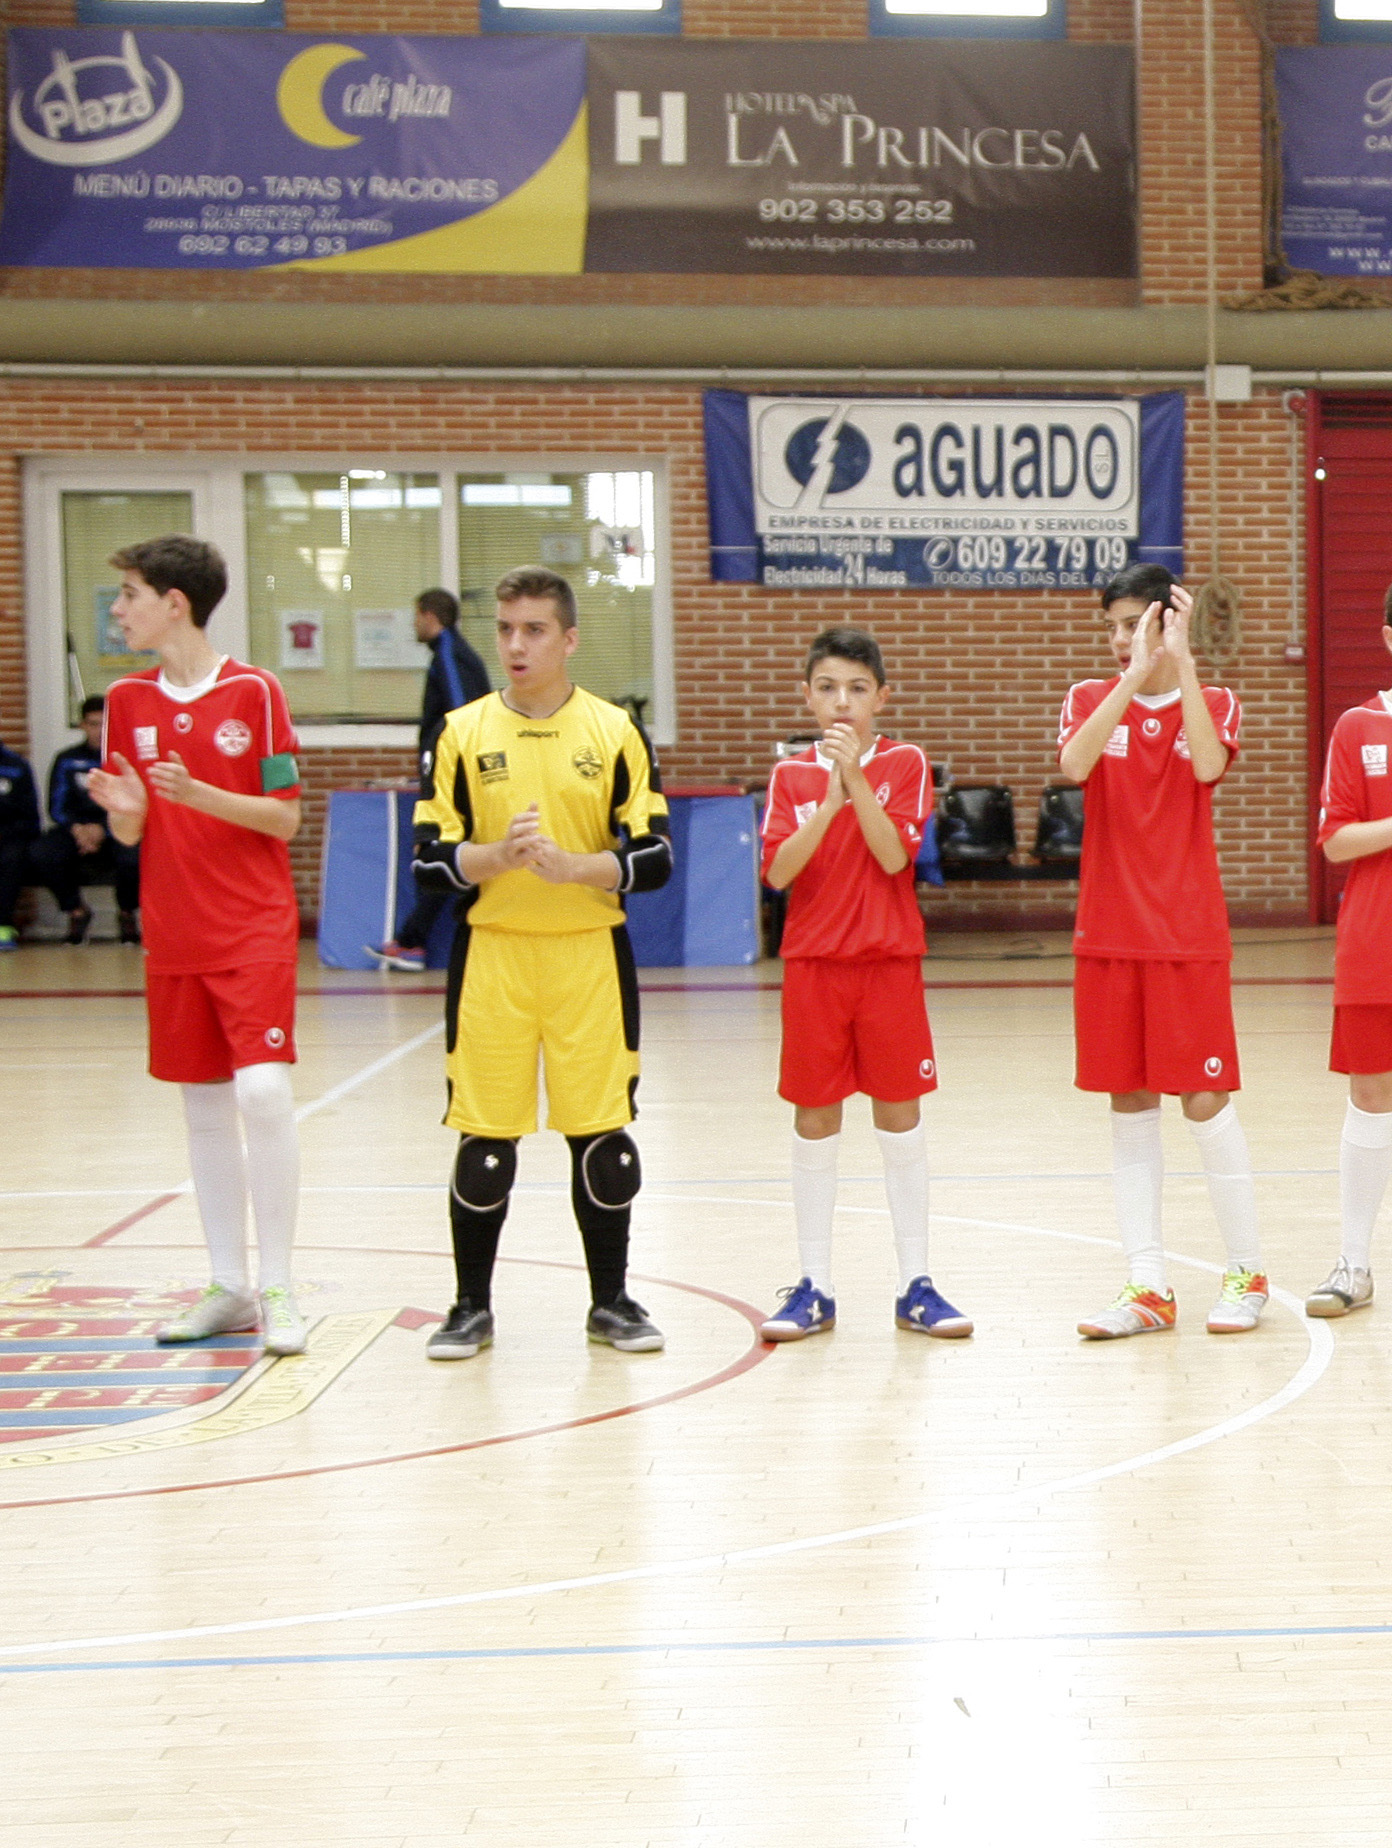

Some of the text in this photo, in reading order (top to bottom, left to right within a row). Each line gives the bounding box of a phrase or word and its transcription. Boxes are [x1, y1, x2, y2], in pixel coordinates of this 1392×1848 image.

[342, 73, 390, 117] café
[615, 91, 686, 165] H
[73, 170, 150, 199] MENÚ
[154, 174, 244, 200] DIARIO
[262, 175, 343, 200] TAPAS
[346, 176, 366, 200] Y
[367, 175, 500, 202] RACIONES
[759, 199, 954, 224] 902 353 252
[746, 234, 976, 254] www.laprincesa.com
[769, 515, 1129, 533] EMPRESA DE ELECTRICIDAD Y SERVICIOS
[763, 535, 894, 557] Servicio Urgente de
[956, 536, 1129, 570] 609 22 79 09
[763, 553, 907, 586] Electricidad 24 Horas
[932, 571, 983, 586] TODOS
[987, 572, 1017, 586] LOS
[1020, 571, 1056, 586] DIAS
[1059, 571, 1089, 586] DEL
